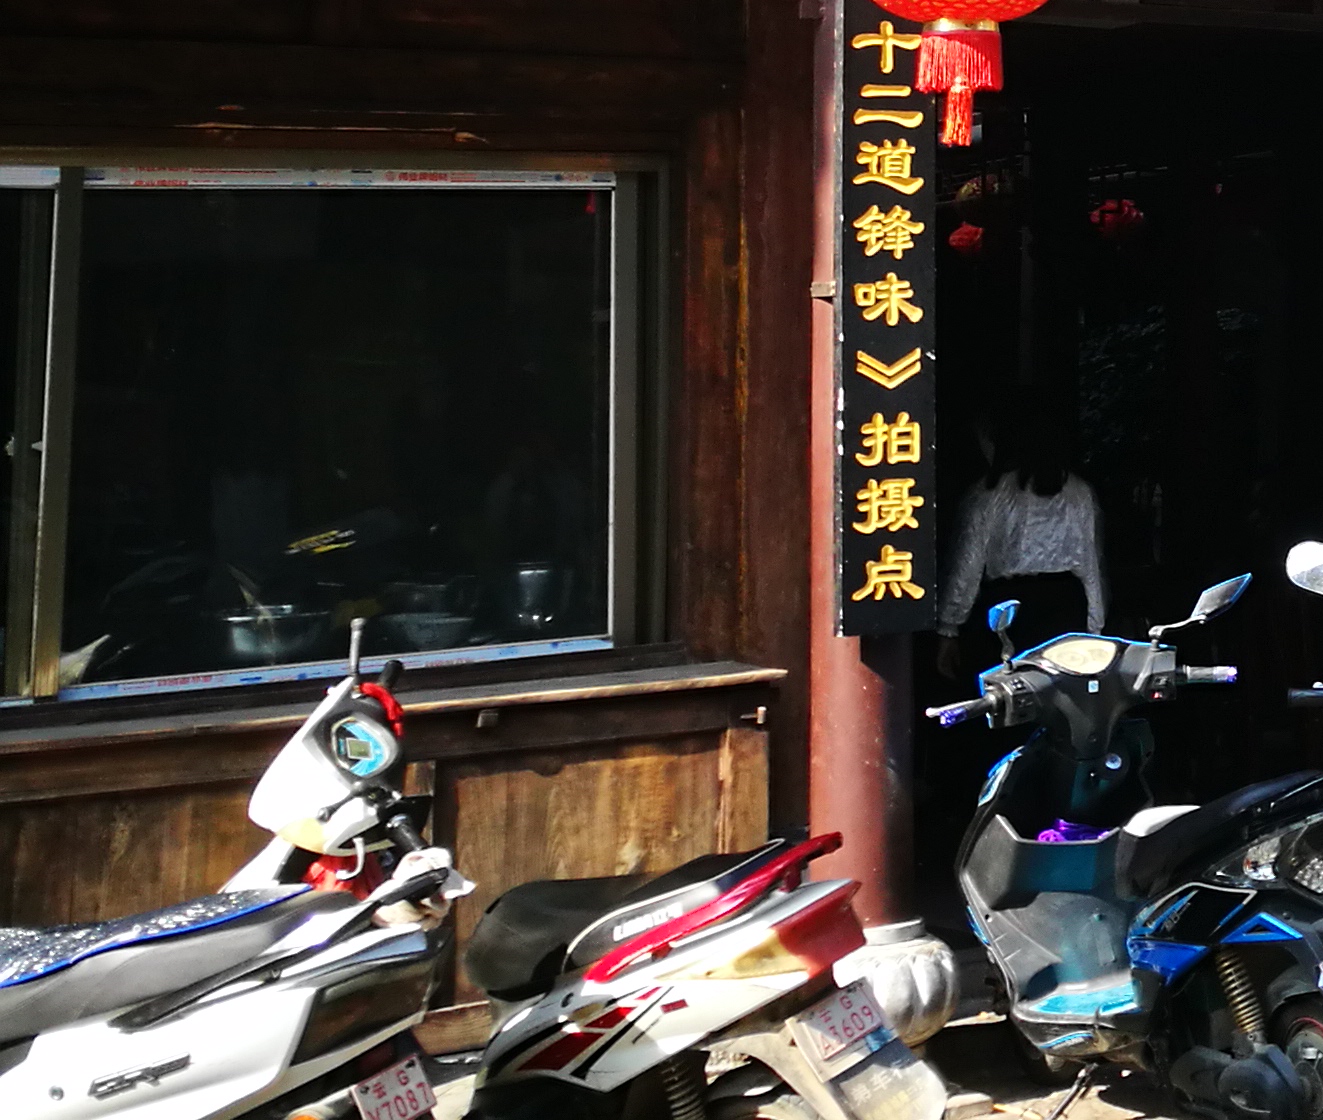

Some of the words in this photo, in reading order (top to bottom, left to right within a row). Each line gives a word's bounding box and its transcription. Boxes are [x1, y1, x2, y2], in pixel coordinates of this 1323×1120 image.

[851, 20, 926, 603] 十二道锋味》拍摄点
